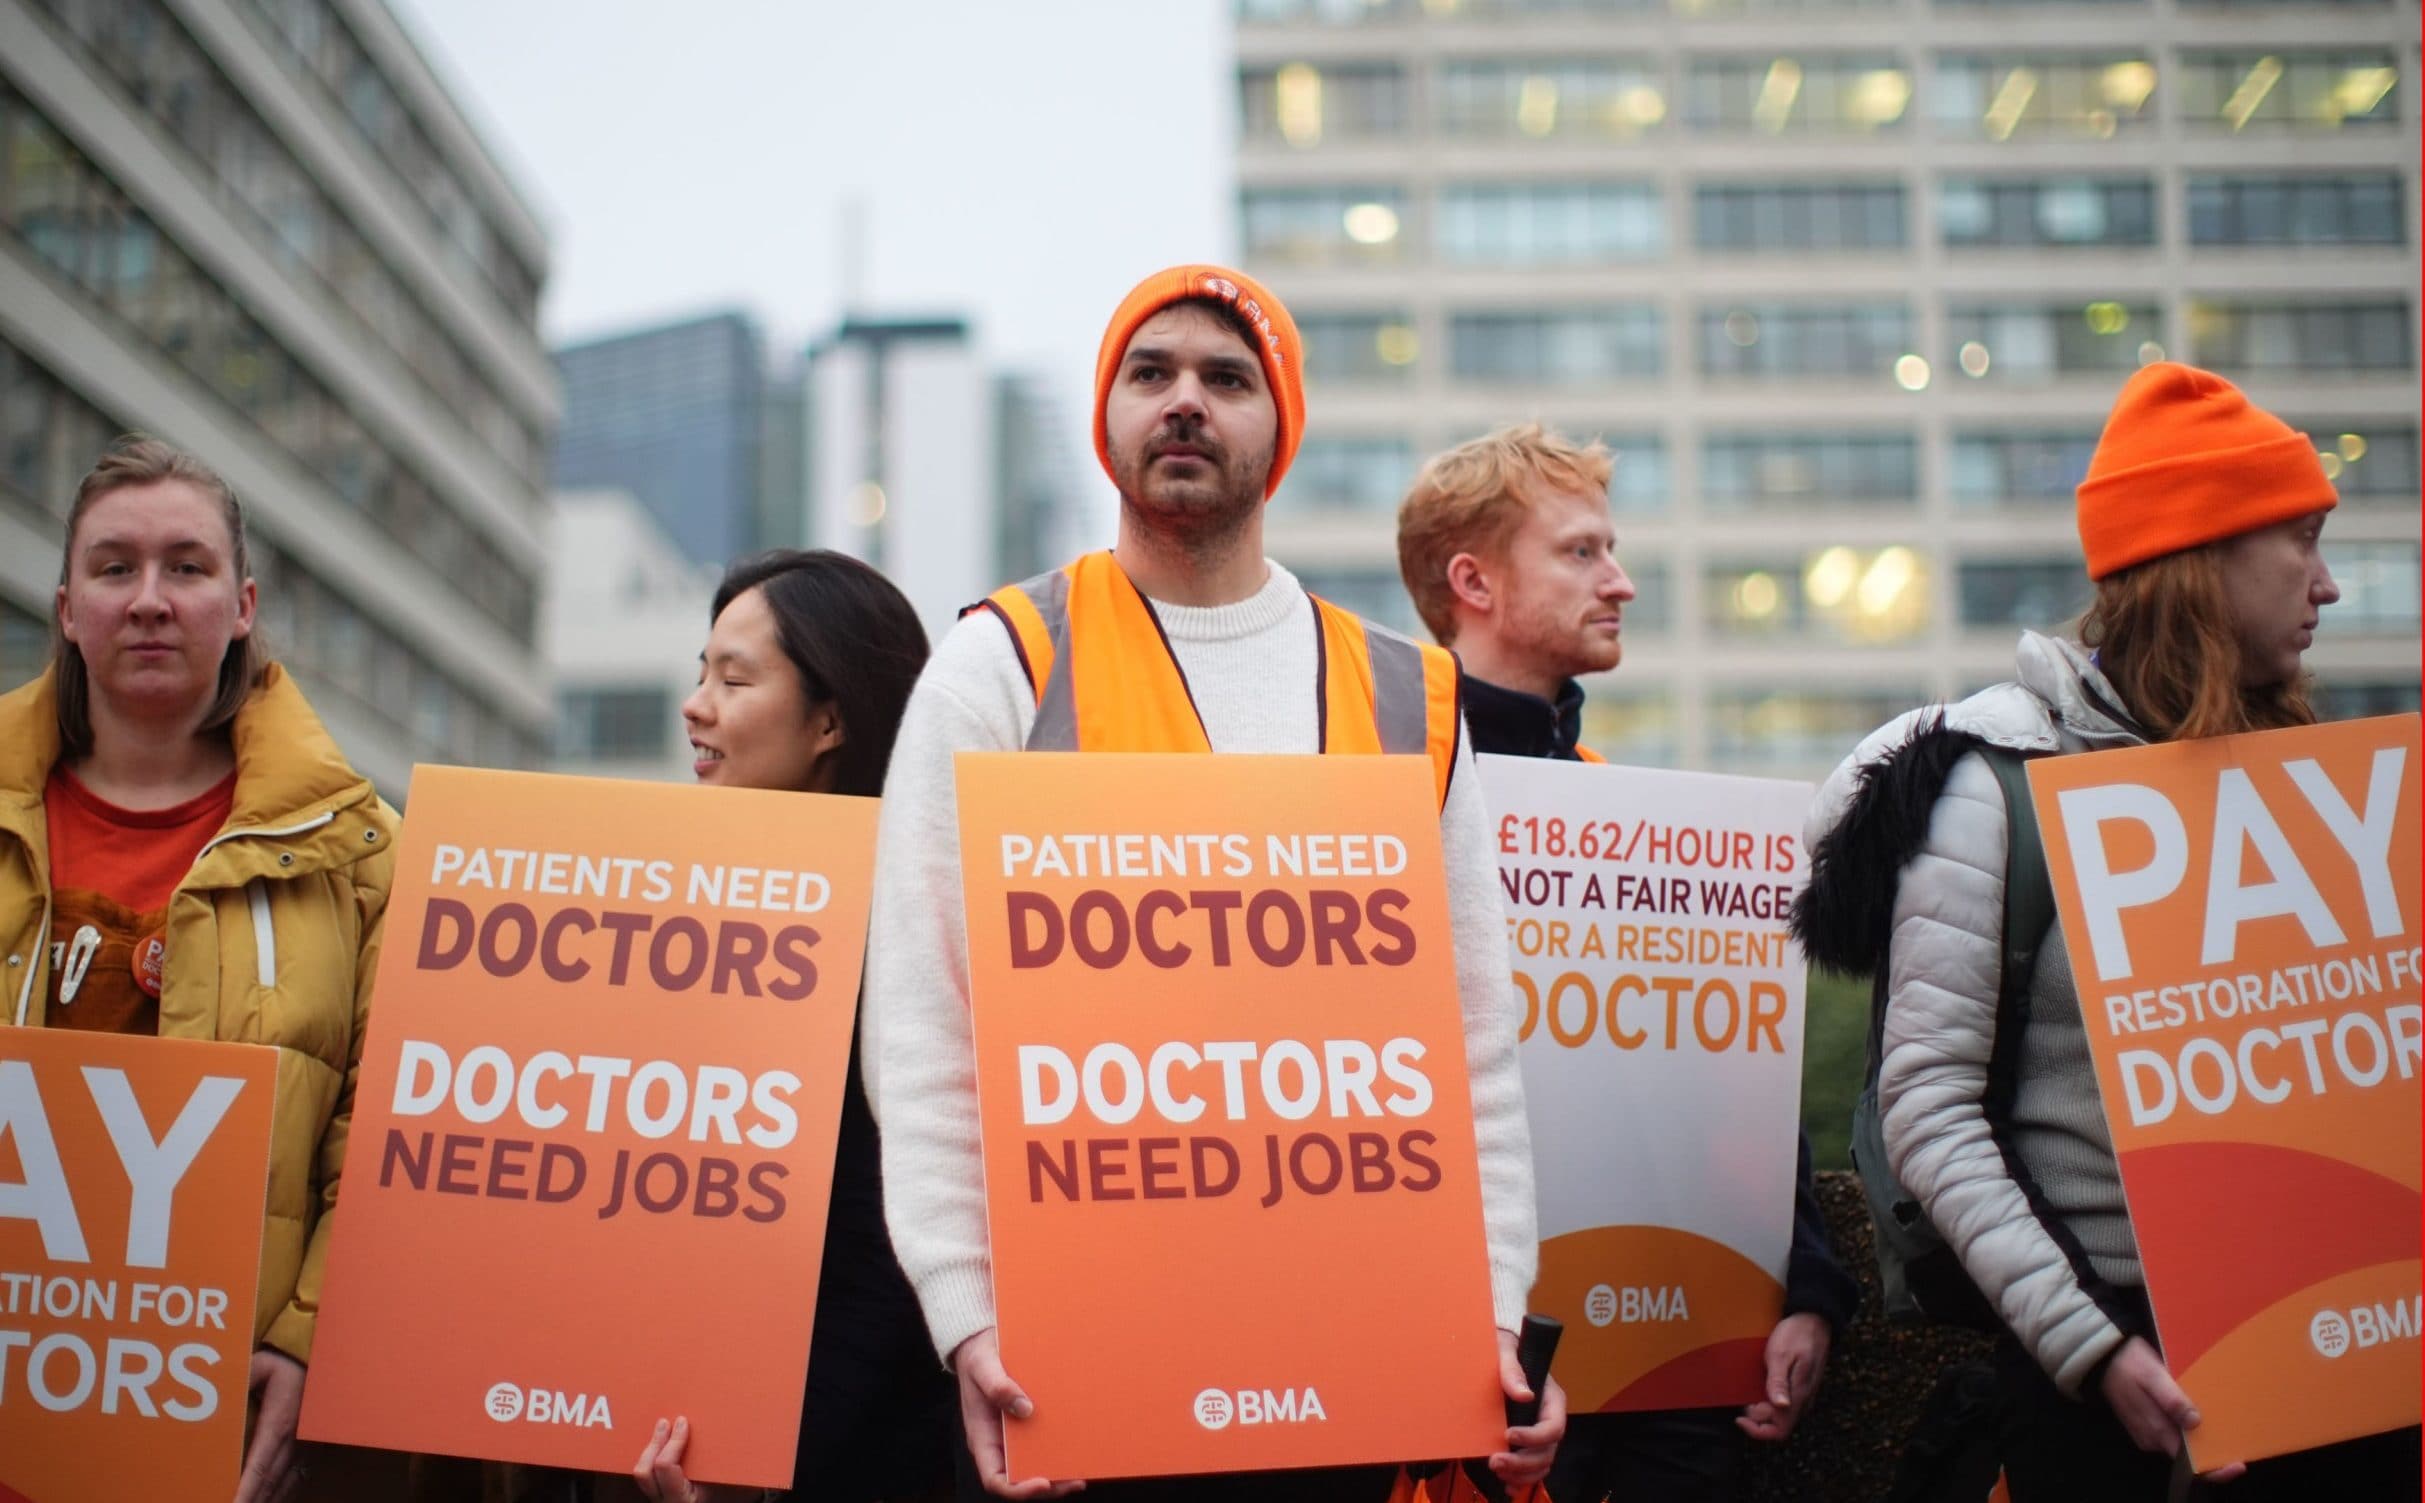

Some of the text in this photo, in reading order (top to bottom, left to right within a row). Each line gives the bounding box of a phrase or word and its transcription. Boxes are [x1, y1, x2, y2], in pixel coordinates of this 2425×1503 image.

[431, 844, 831, 913] PATIENTS NEED
[1001, 834, 1408, 878] PATIENTS NEED
[1498, 814, 1795, 873] £18.62/HOUR IS
[2057, 747, 2407, 981] PAY
[1006, 888, 1417, 969] DOCTORS
[1498, 867, 1792, 920] NOT A FAIR WAGE
[416, 897, 822, 1001] DOCTORS
[1580, 923, 1605, 959] A
[1617, 924, 1792, 968] RESIDENT
[2105, 955, 2382, 1036] RESTORATION
[392, 1040, 802, 1149] DOCTORS
[1018, 1037, 1433, 1125] DOCTORS
[2118, 1004, 2422, 1127] DOCTOR
[379, 1128, 790, 1223] NEED JOBS
[1026, 1129, 1441, 1208] NEED JOBS
[0, 1272, 228, 1329] TION FOR
[1621, 1286, 1690, 1323] BMA
[526, 1388, 613, 1430] BMA
[1237, 1387, 1327, 1425] BMA
